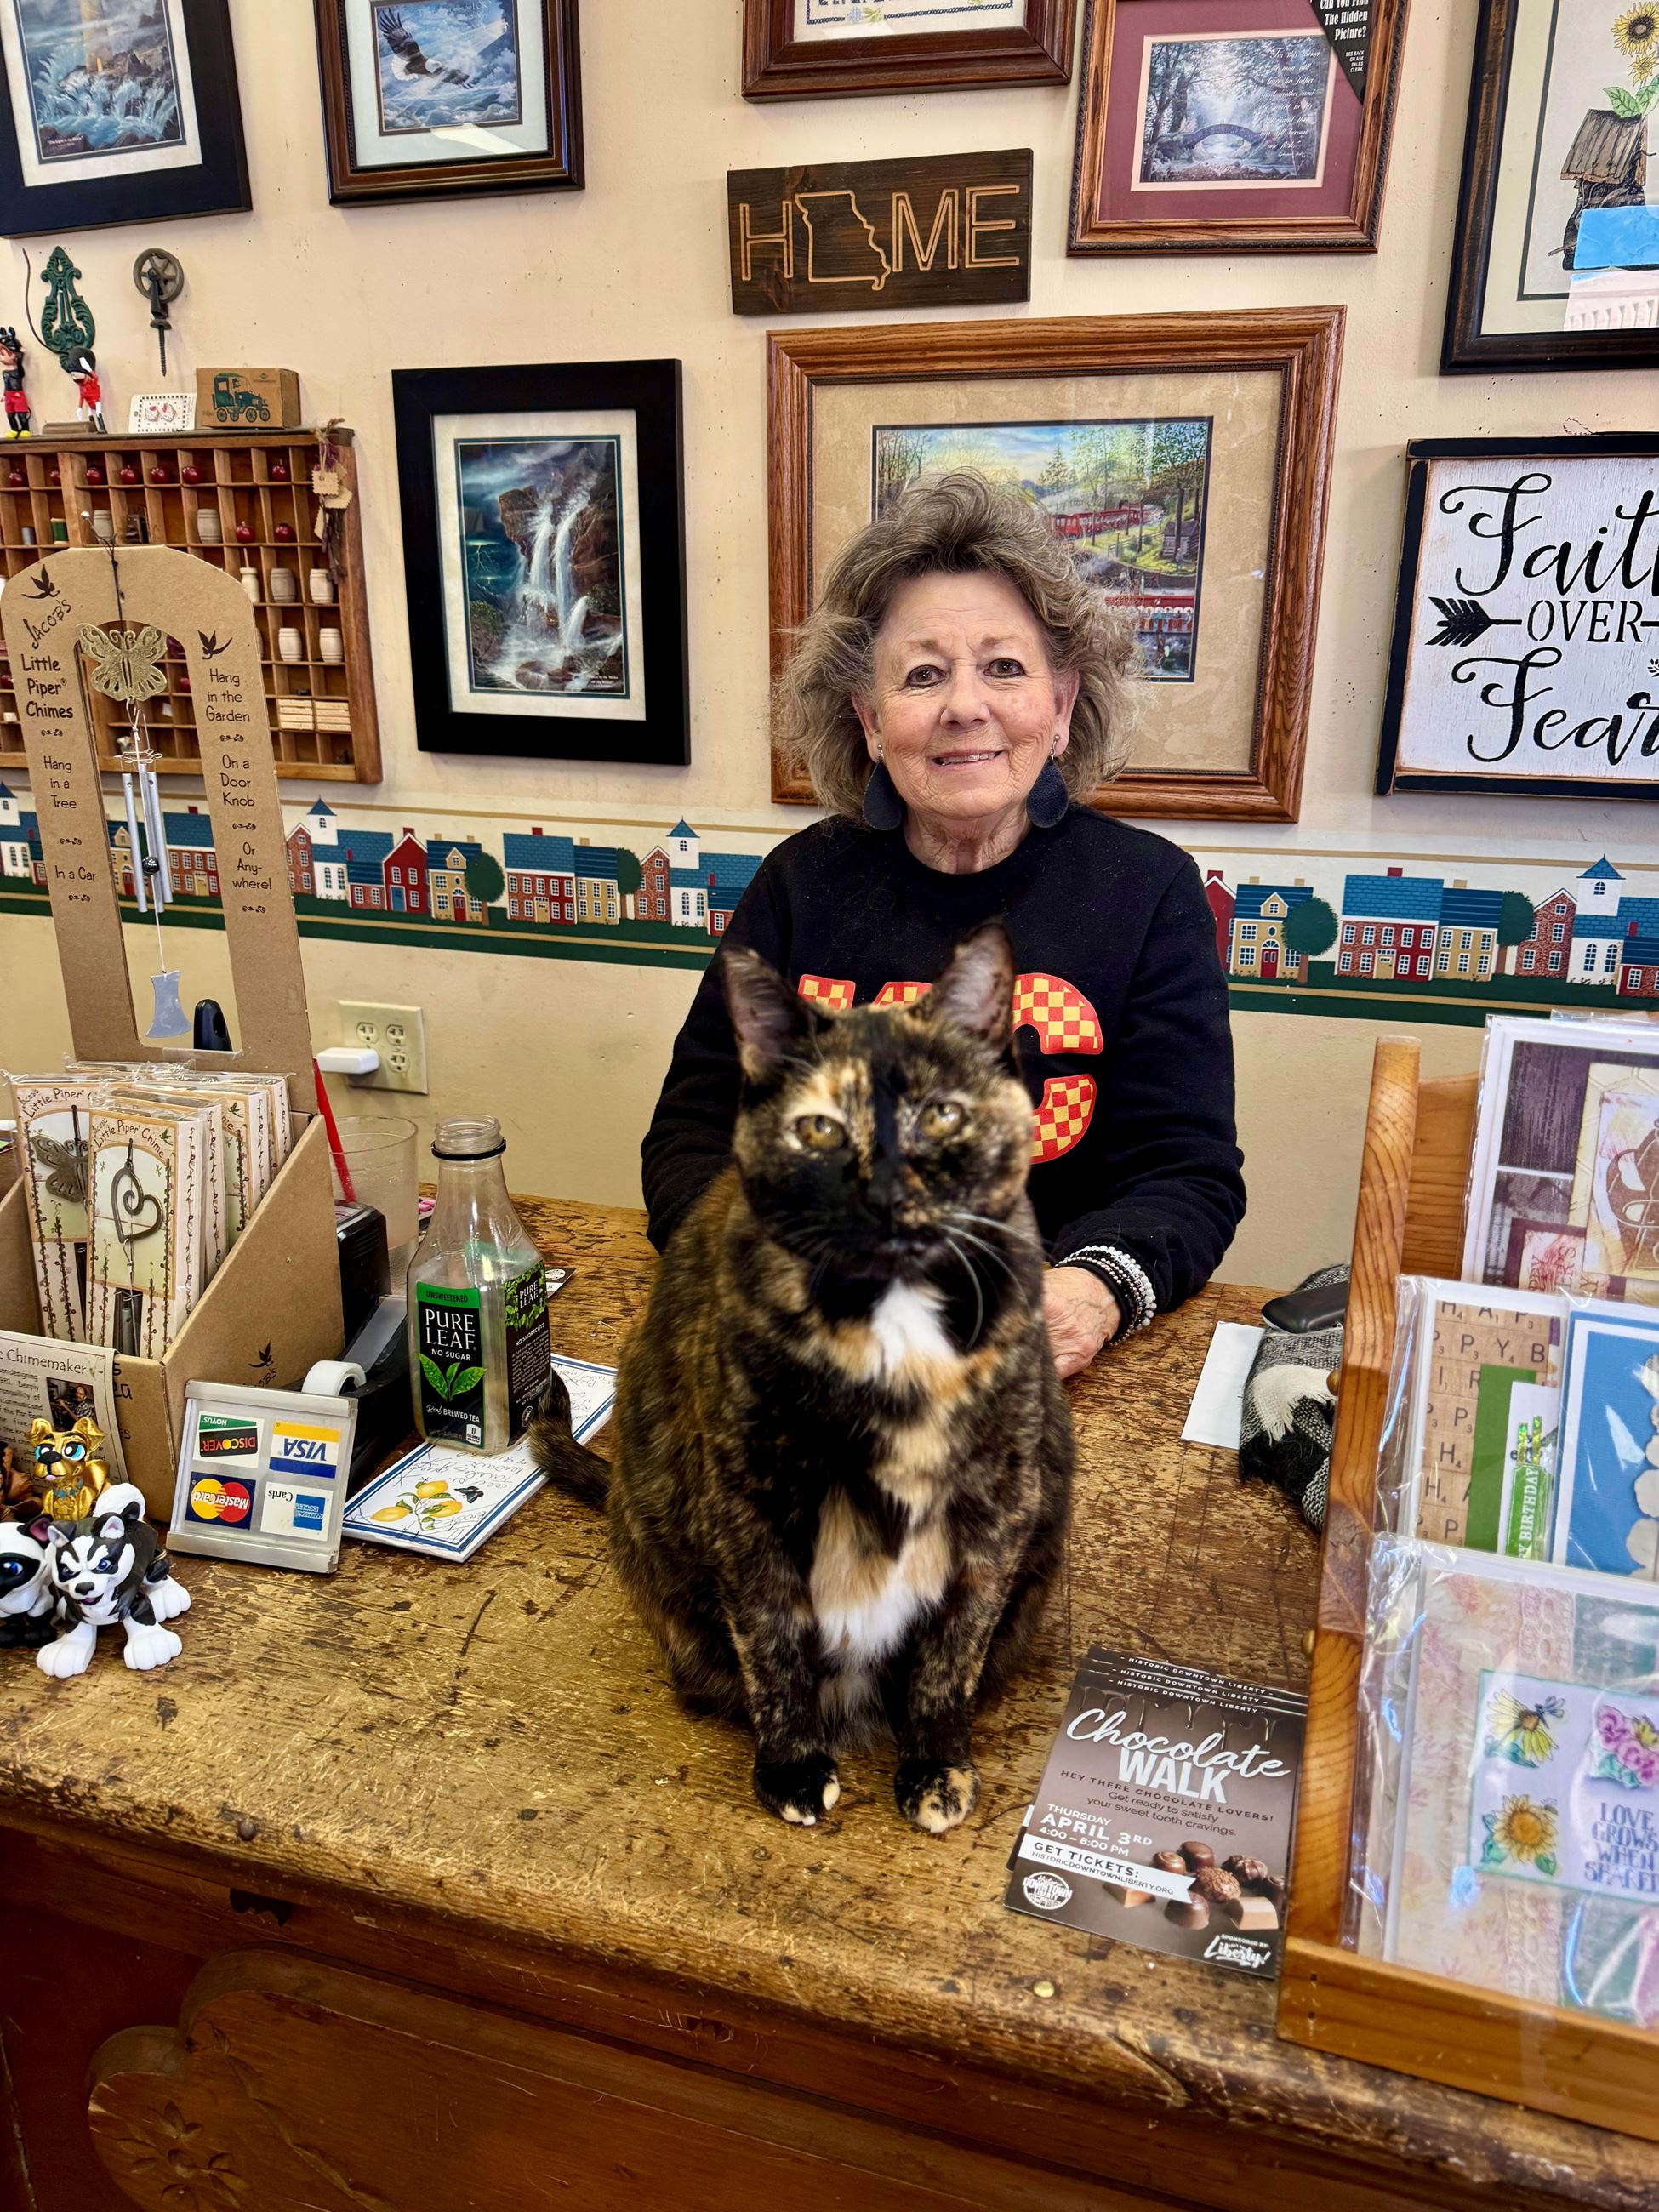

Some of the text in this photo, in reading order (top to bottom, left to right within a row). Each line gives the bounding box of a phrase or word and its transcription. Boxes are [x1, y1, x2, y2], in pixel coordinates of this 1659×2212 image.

[1325, 10, 1368, 26] The Hidden
[1334, 26, 1367, 41] Picture?
[1440, 473, 1659, 596] Fait
[23, 599, 71, 650] JACOB'S
[1527, 599, 1645, 644] OVER
[20, 653, 61, 672] Little
[209, 668, 241, 687] Hang
[207, 690, 242, 703] in the
[26, 700, 73, 719] Chimes
[205, 705, 250, 722] Garden
[43, 755, 72, 773] Hang
[222, 754, 250, 769] On a
[49, 778, 70, 789] in a
[219, 772, 251, 788] Door
[50, 795, 77, 809] Tree
[223, 792, 255, 807] Knob
[242, 841, 255, 855] Or
[54, 864, 96, 881] In a Car
[237, 858, 262, 875] Any-
[231, 877, 272, 890] where!
[23, 1095, 53, 1118] Little
[94, 1126, 117, 1149] Little
[141, 1127, 164, 1159] Chime
[425, 1290, 468, 1303] UNSWEETENED
[519, 1280, 539, 1298] PURE
[519, 1292, 539, 1309] LEAF
[425, 1308, 476, 1332] PURE
[425, 1326, 476, 1350] LEAF
[515, 1322, 545, 1347] NO SHORTCUTS
[6, 1348, 87, 1375] Chimemaker
[431, 1348, 471, 1361] NO SUGAR
[203, 1416, 227, 1426] NOVUS
[425, 1404, 481, 1423] Real BREWED TEA
[471, 1427, 476, 1435] 0
[202, 1436, 256, 1451] DISCOVER
[283, 1438, 327, 1462] VISA
[192, 1490, 249, 1510] MasterCard
[268, 1489, 294, 1502] Cards
[1521, 1467, 1539, 1539] BIRTHDAY
[1120, 1669, 1260, 1703] HISTORIC DOWNTOWN LIBERTY
[1128, 1657, 1266, 1695] HISTORIC DOWNTOWN LIBERTY
[1117, 1679, 1258, 1714] HISTORIC DOWNTOWN LIBERTY
[1066, 1707, 1291, 1778] Chocolate
[1117, 1747, 1231, 1804] WALK
[1061, 1770, 1274, 1822] HEY THERE CHOCOLATE LOVERS!
[1047, 1803, 1112, 1827] THURSDAY
[1086, 1797, 1236, 1837] your sweet tooth cravings.
[1109, 1791, 1219, 1823] Get ready to satisfy
[1600, 1802, 1654, 1831] LOVE
[1040, 1813, 1153, 1846] APRIL 3RD
[1592, 1821, 1658, 1852] GROWS
[1039, 1827, 1130, 1856] 4:00 8:00 PM
[1034, 1842, 1139, 1878] GET TICKETS:
[1595, 1842, 1654, 1871] WHEN
[1031, 1851, 1174, 1896] HISTORICDOWNTOWNLIBERTY.ORG
[1023, 1877, 1073, 1900] DOWNTOWN
[1221, 1933, 1258, 1946] SPONSORED
